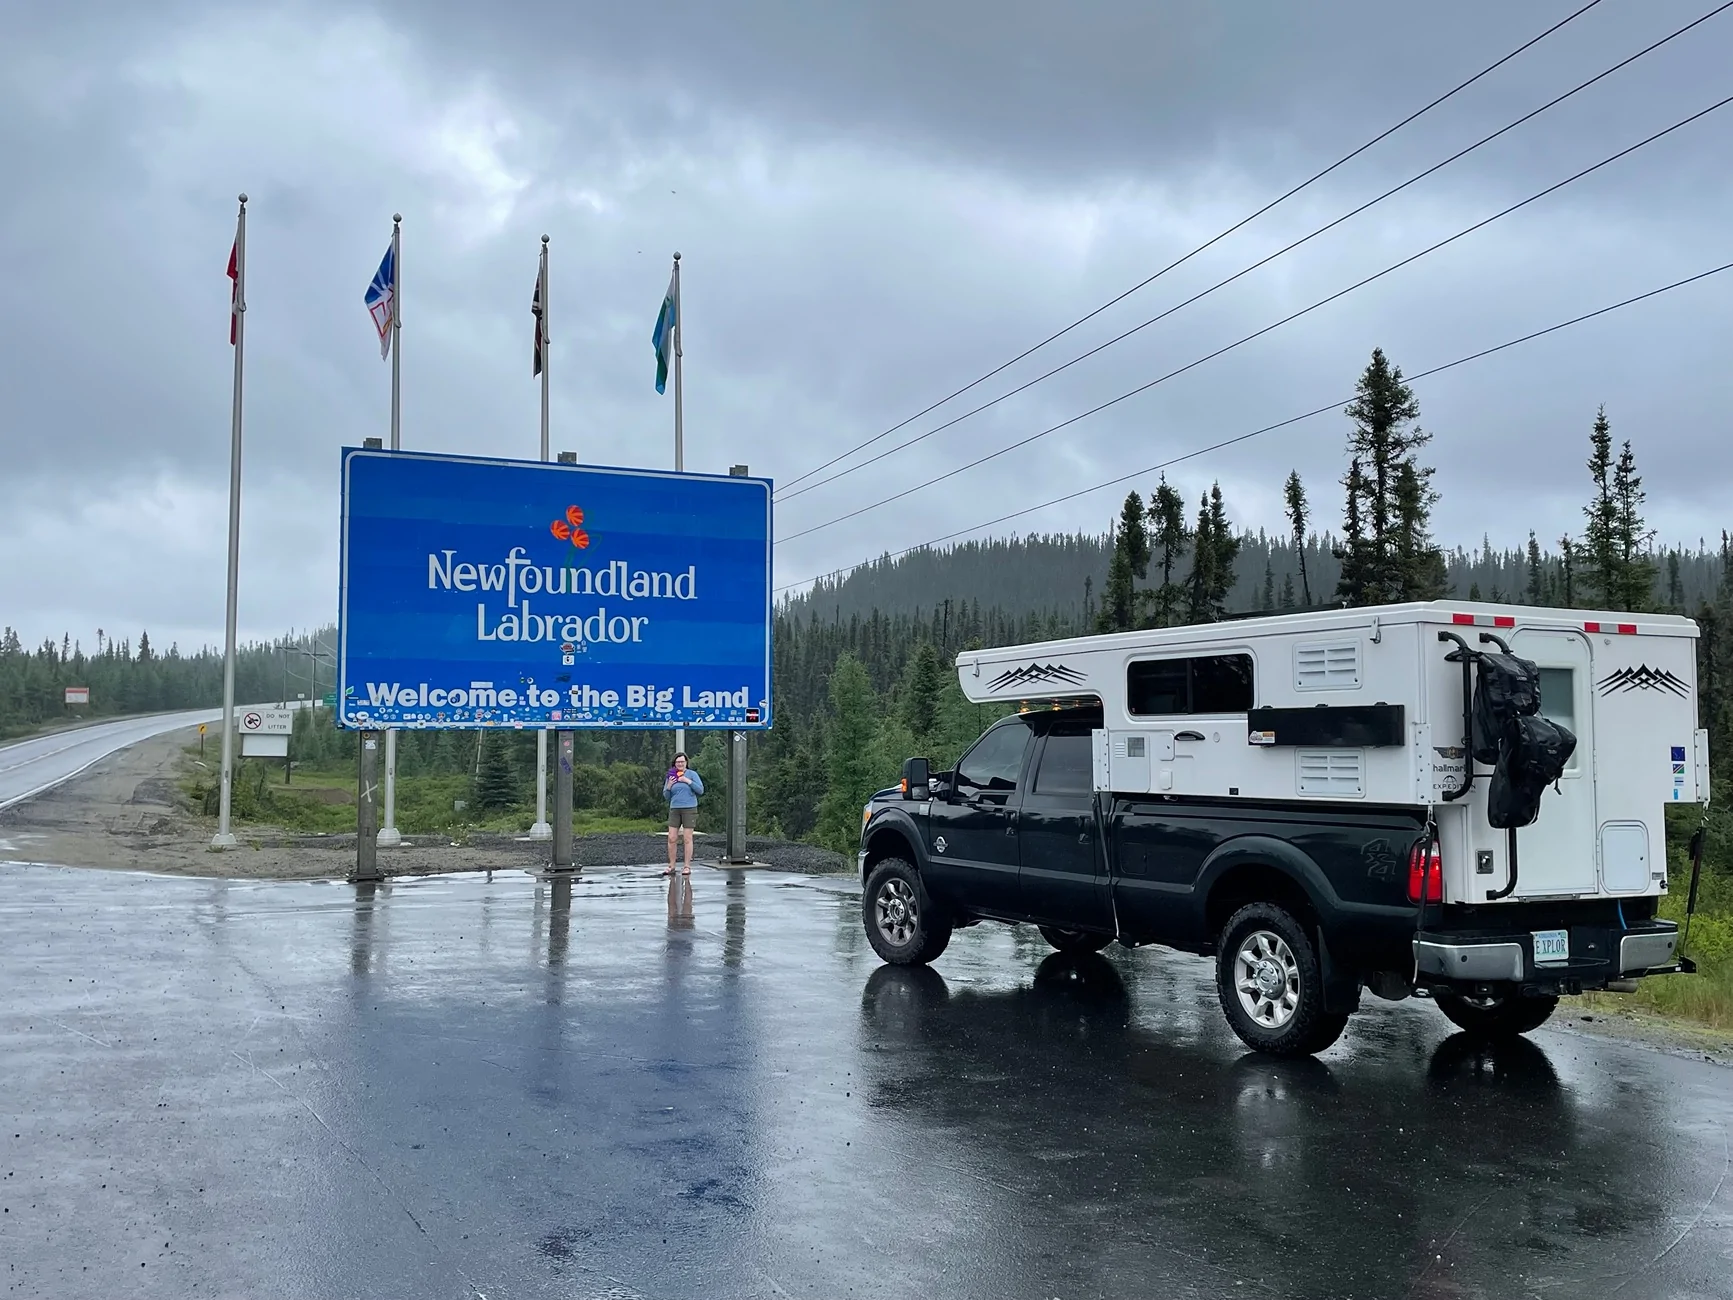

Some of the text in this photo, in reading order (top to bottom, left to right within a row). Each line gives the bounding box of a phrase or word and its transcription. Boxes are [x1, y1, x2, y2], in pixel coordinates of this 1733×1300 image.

[428, 547, 698, 608] Newfoundland
[477, 600, 649, 643] Labrador
[366, 682, 749, 713] Welcome to the Big Land
